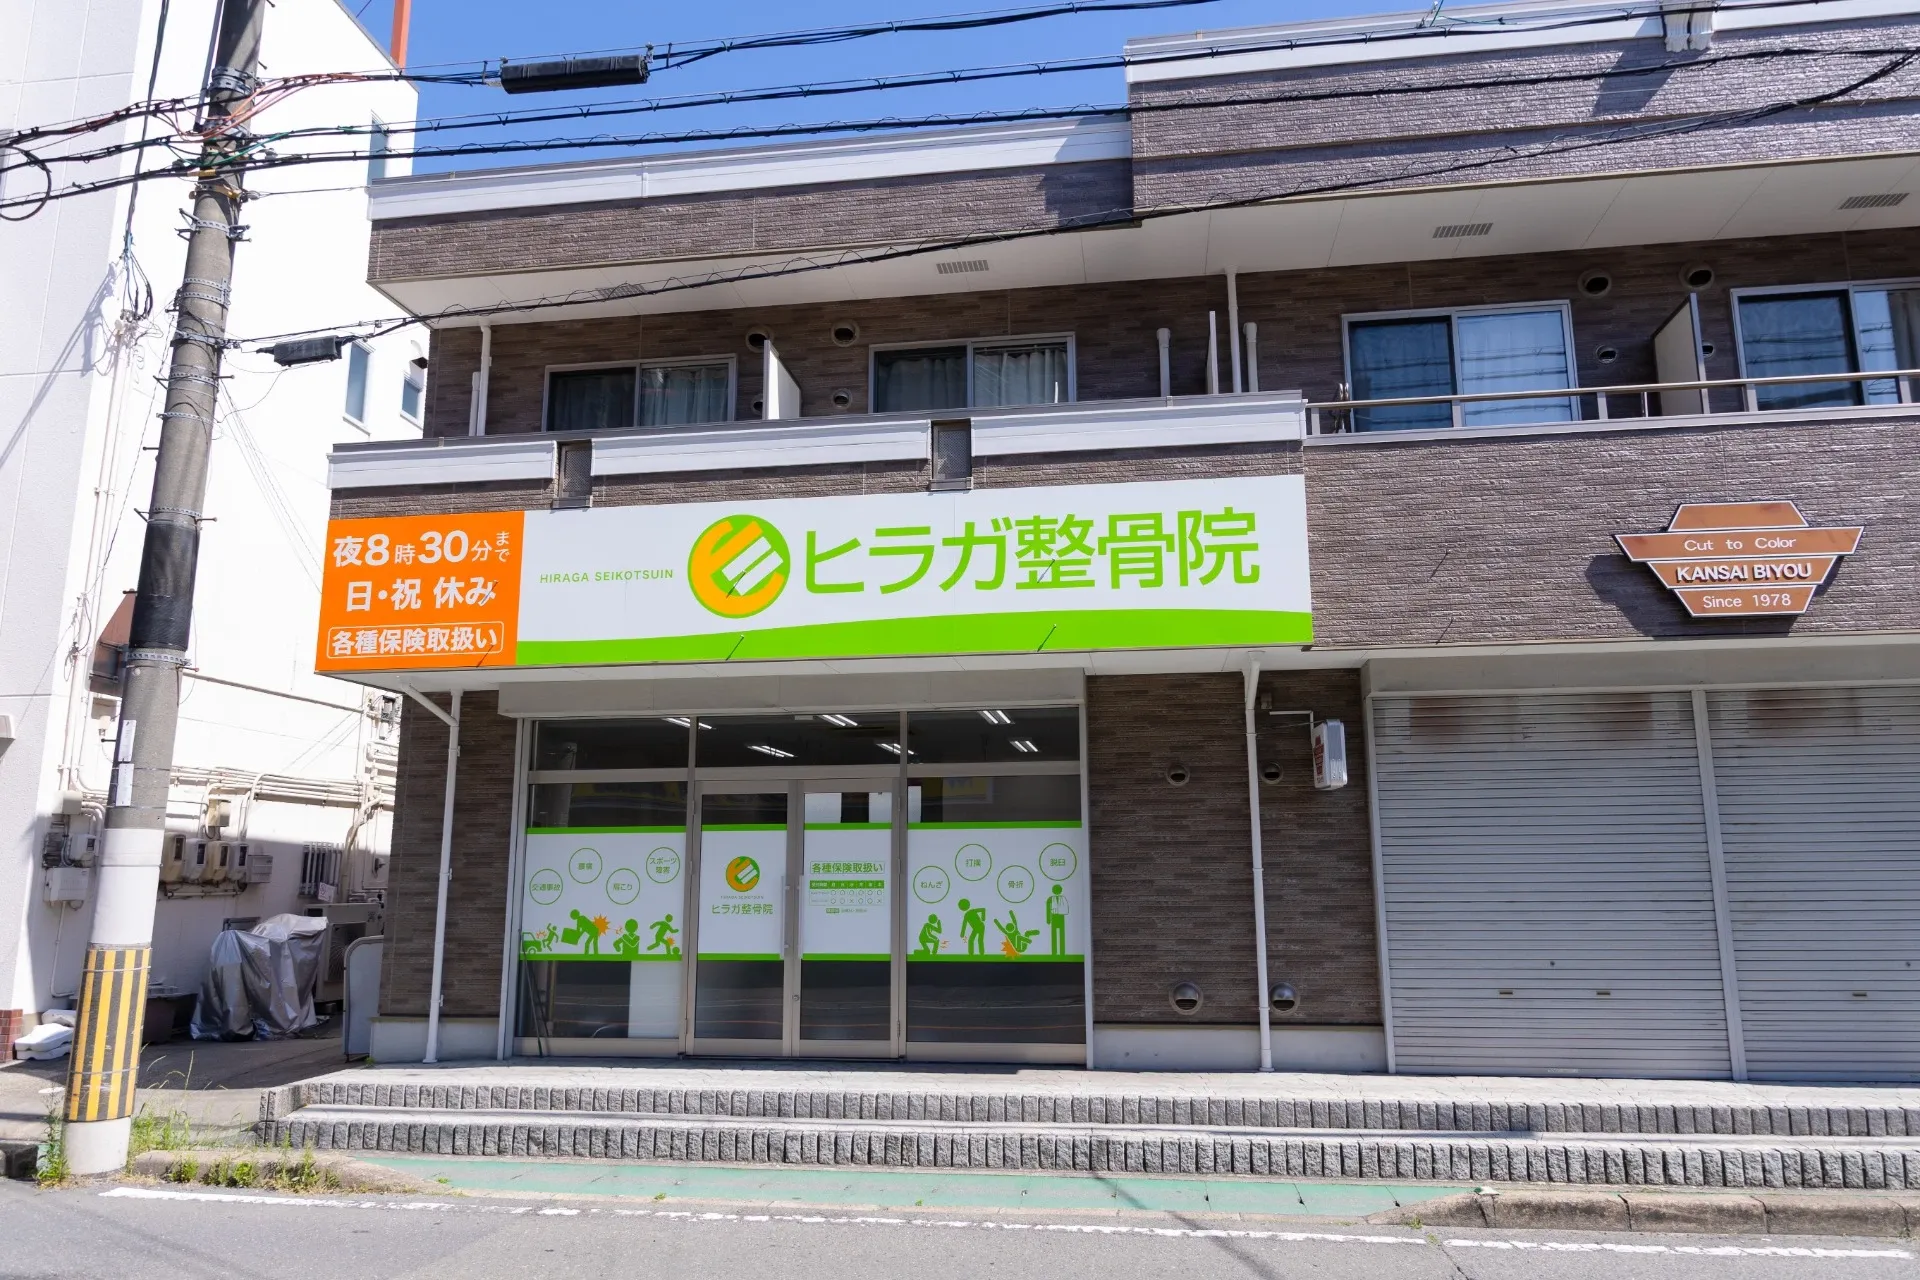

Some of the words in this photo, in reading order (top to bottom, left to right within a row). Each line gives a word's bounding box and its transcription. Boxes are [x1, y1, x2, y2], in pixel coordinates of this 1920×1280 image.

[805, 506, 1261, 594] ヒラガ整骨院
[1684, 540, 1714, 551] Cut
[1726, 539, 1743, 550] to
[1755, 537, 1797, 549] Color
[540, 572, 590, 583] HIRAGA
[594, 569, 674, 582] SEIKOTSUIN
[1676, 564, 1749, 581] KANSAI
[1753, 562, 1812, 579] BIYOU
[433, 576, 496, 609] 休み
[1703, 595, 1742, 608] Since
[1752, 593, 1791, 607] 1978
[332, 626, 498, 656] 各種保険取扱い
[812, 862, 883, 874] 各種保険取扱い
[712, 903, 774, 915] ヒラガ整骨院
